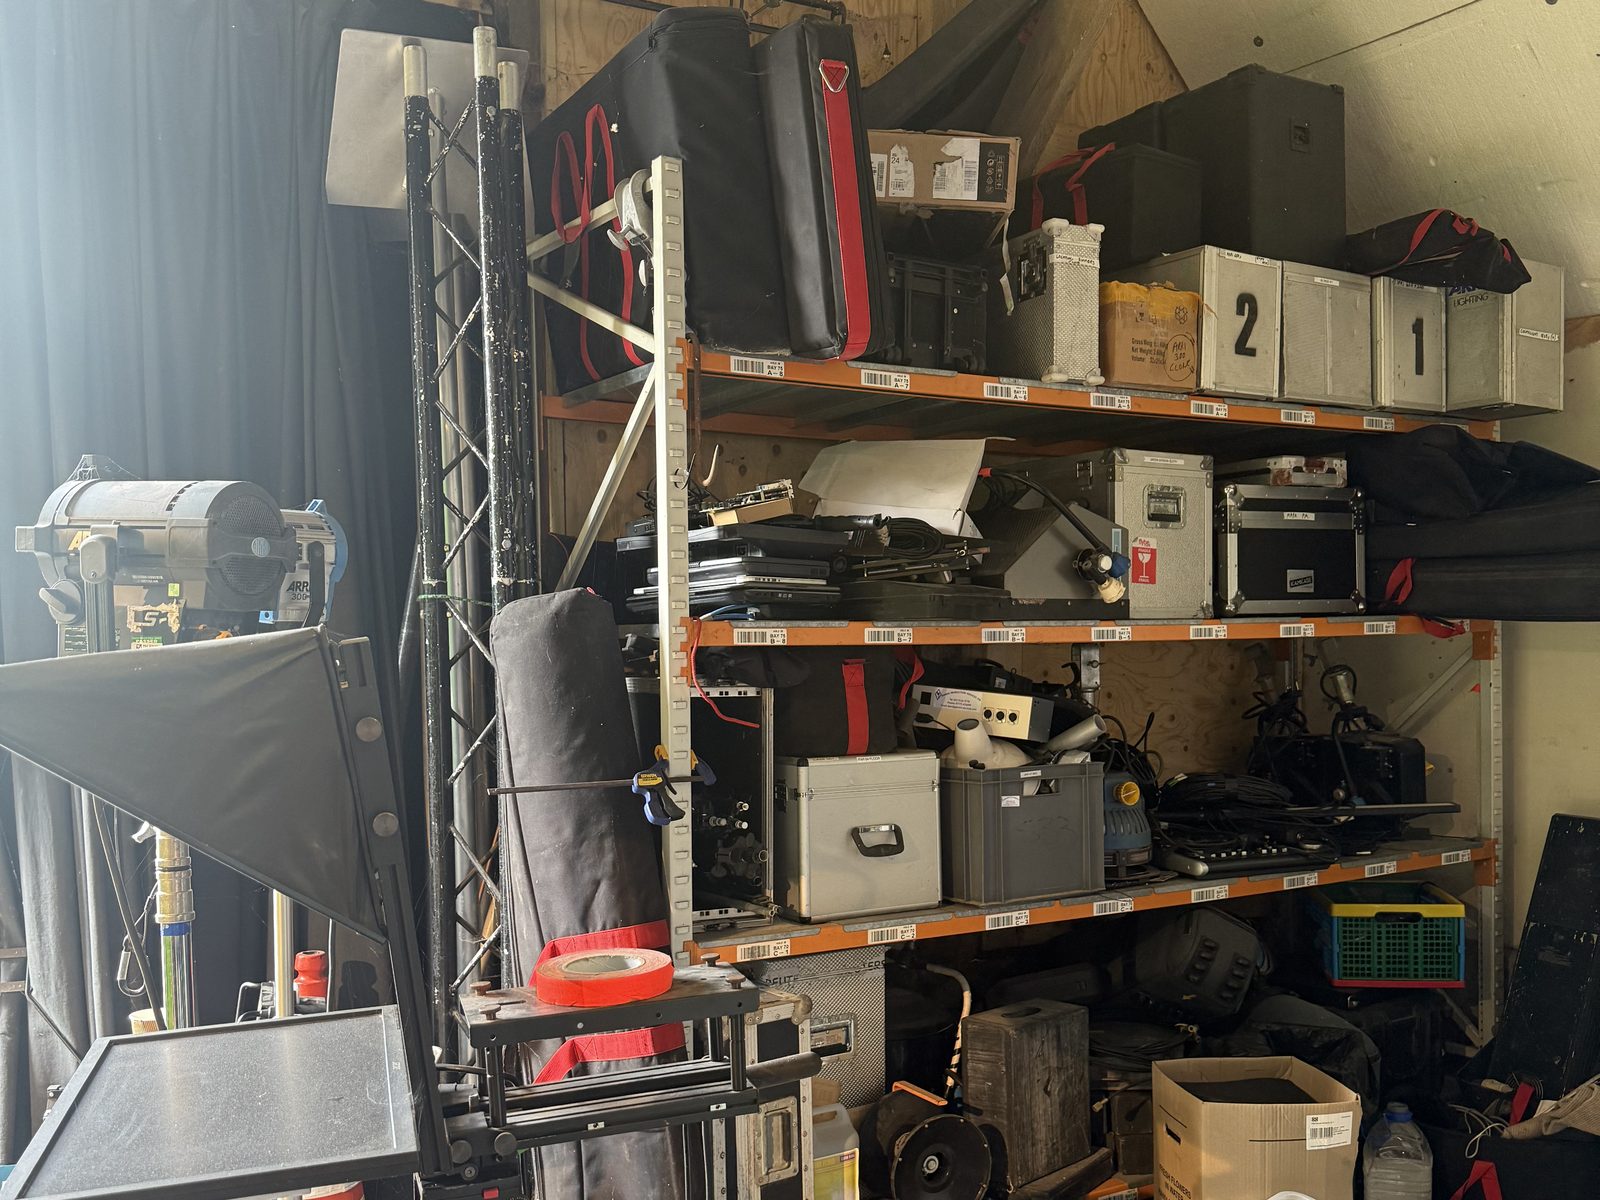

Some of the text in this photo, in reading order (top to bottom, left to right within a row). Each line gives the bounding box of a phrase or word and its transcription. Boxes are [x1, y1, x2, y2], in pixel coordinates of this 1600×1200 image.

[1453, 293, 1489, 307] LIGHTING
[1235, 292, 1258, 357] 2
[1412, 317, 1424, 375] 1
[286, 581, 309, 592] ARR
